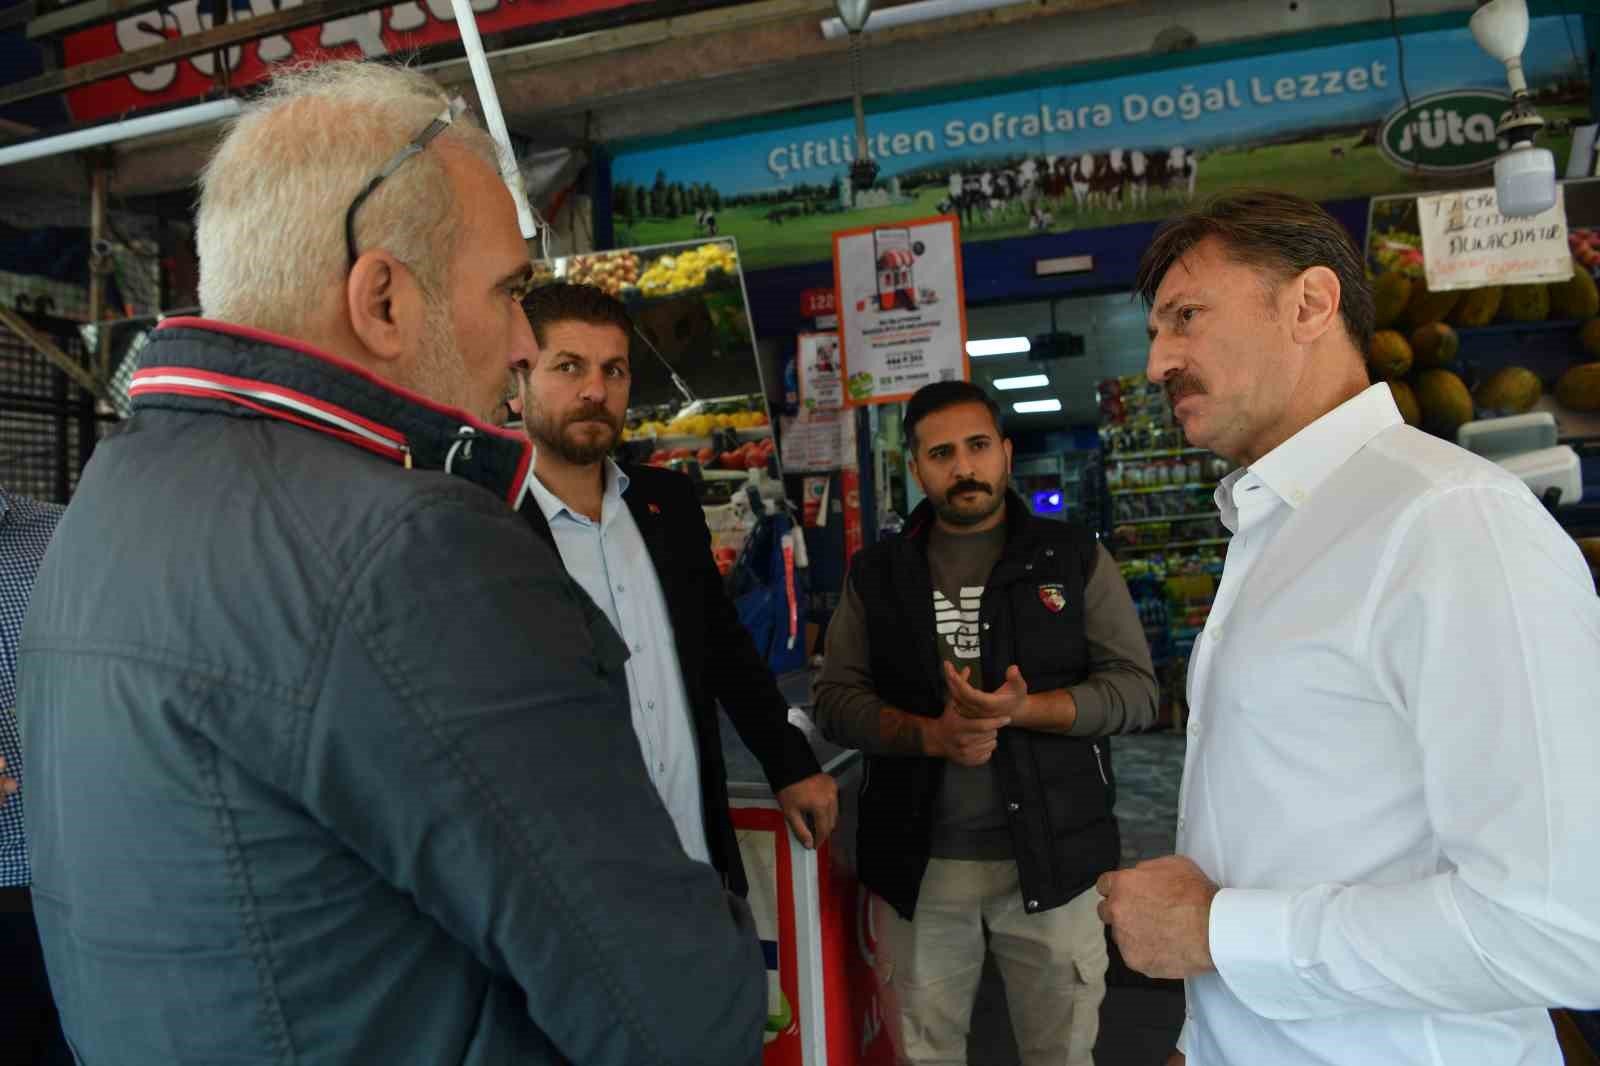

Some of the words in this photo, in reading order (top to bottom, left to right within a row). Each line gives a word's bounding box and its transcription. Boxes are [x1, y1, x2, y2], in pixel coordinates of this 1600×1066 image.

[944, 103, 1112, 148] Sofralara
[1123, 78, 1241, 123] Doğal
[1251, 60, 1388, 104] Lezzet
[1399, 109, 1509, 151] süta
